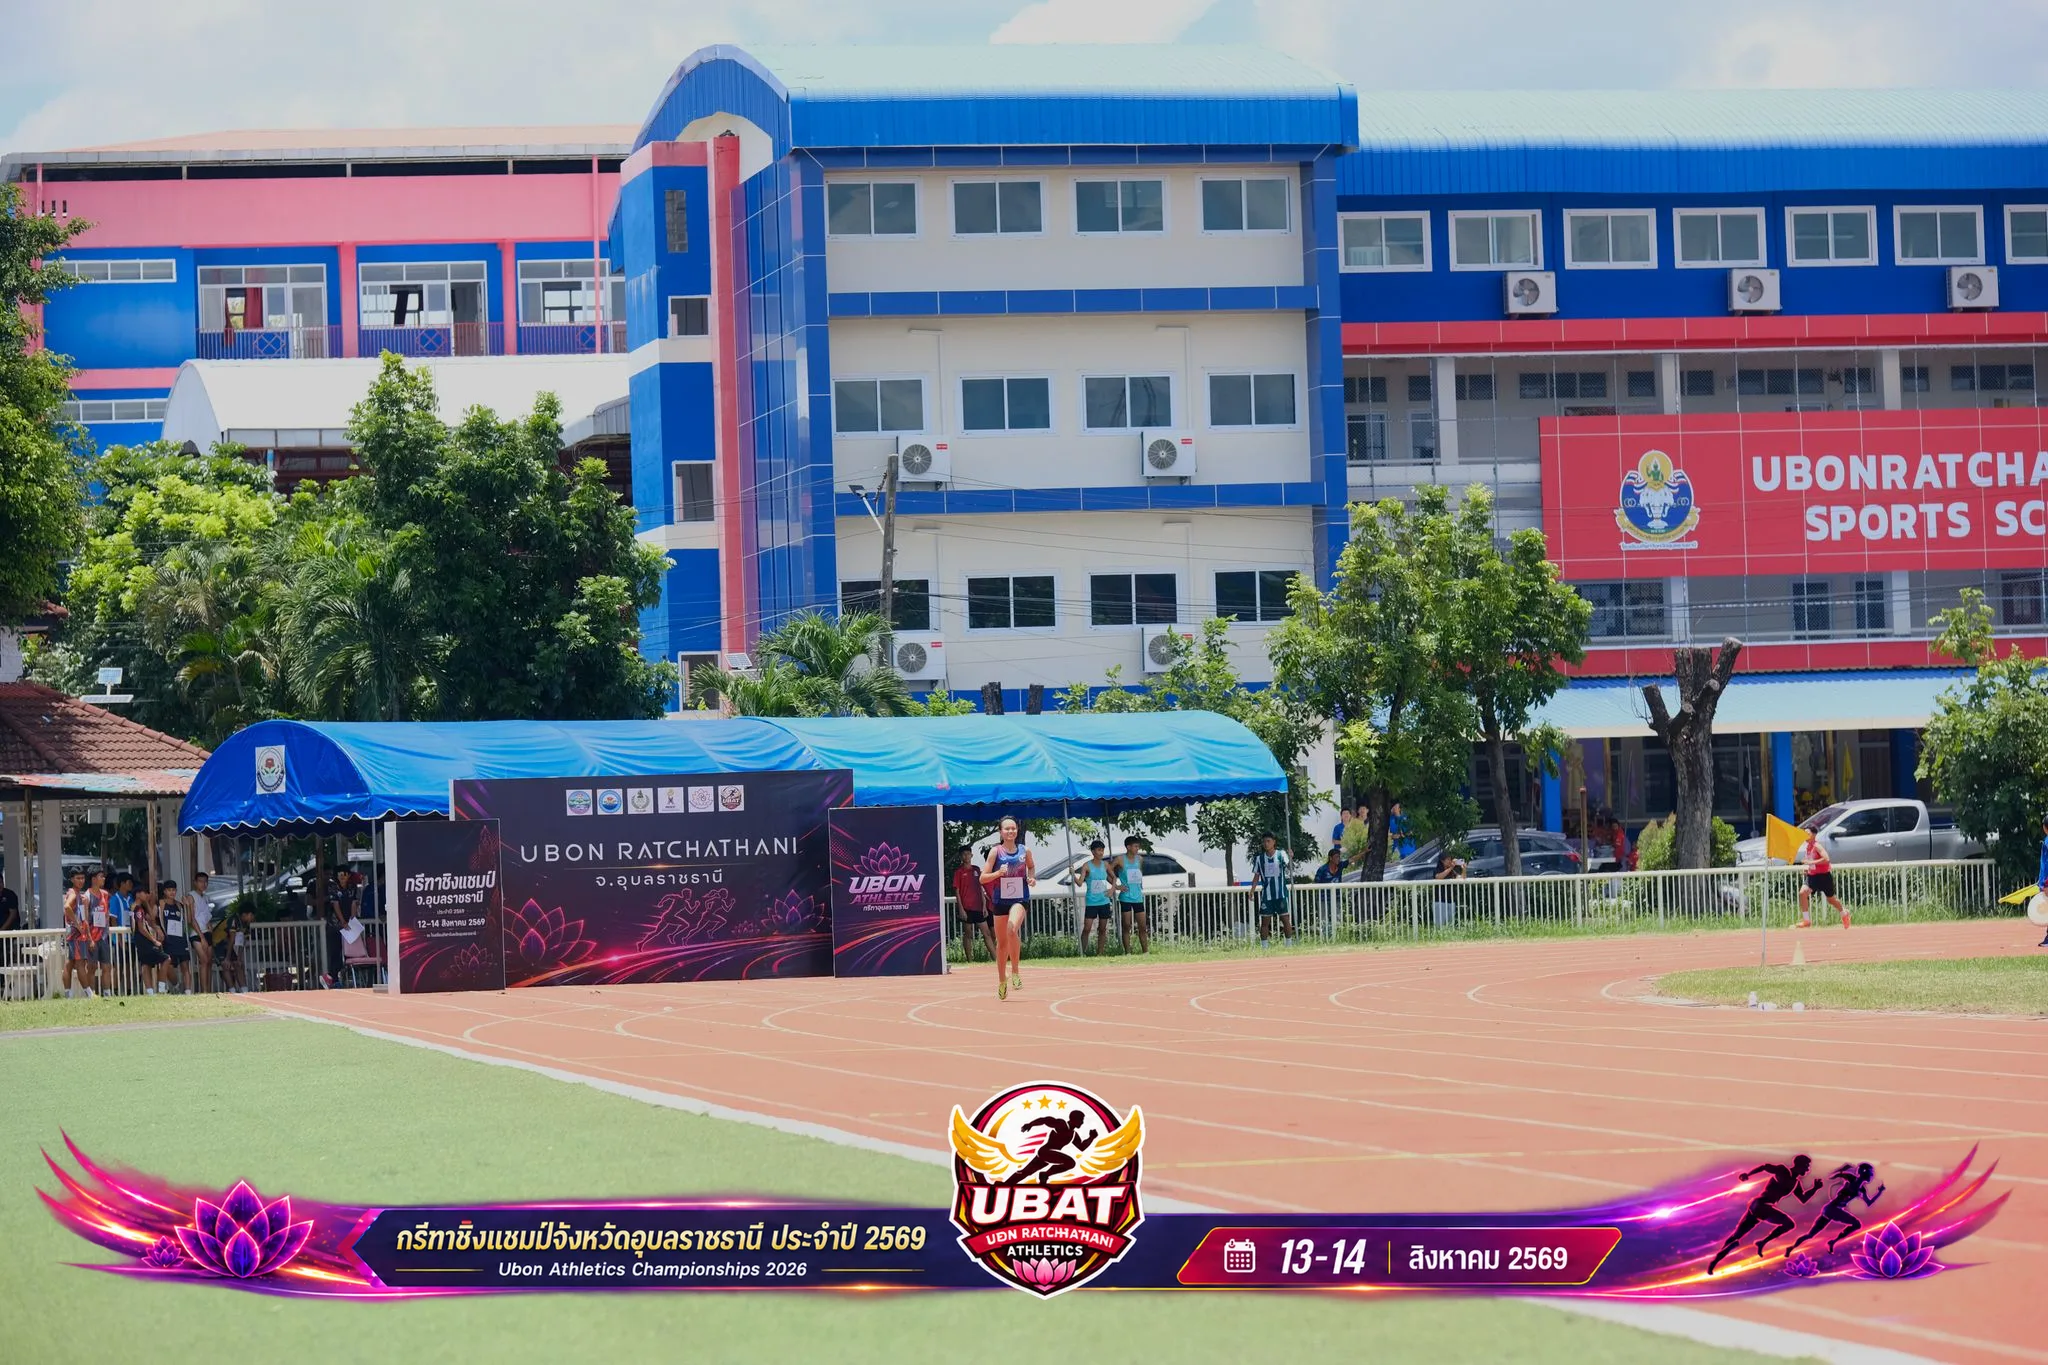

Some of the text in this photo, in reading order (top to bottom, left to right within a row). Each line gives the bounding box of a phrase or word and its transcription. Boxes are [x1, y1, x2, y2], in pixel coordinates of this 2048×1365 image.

[1805, 499, 2048, 541] SPORTS SC
[520, 837, 797, 863] UBON RATCHATHANI
[404, 870, 496, 892] กรีฑาชิงแชมป์
[595, 868, 723, 891] จ.อุบลราชธานี
[848, 874, 926, 893] UBON
[1006, 882, 1017, 897] 5
[850, 892, 922, 903] ATHLETICS
[468, 917, 486, 926] 2569
